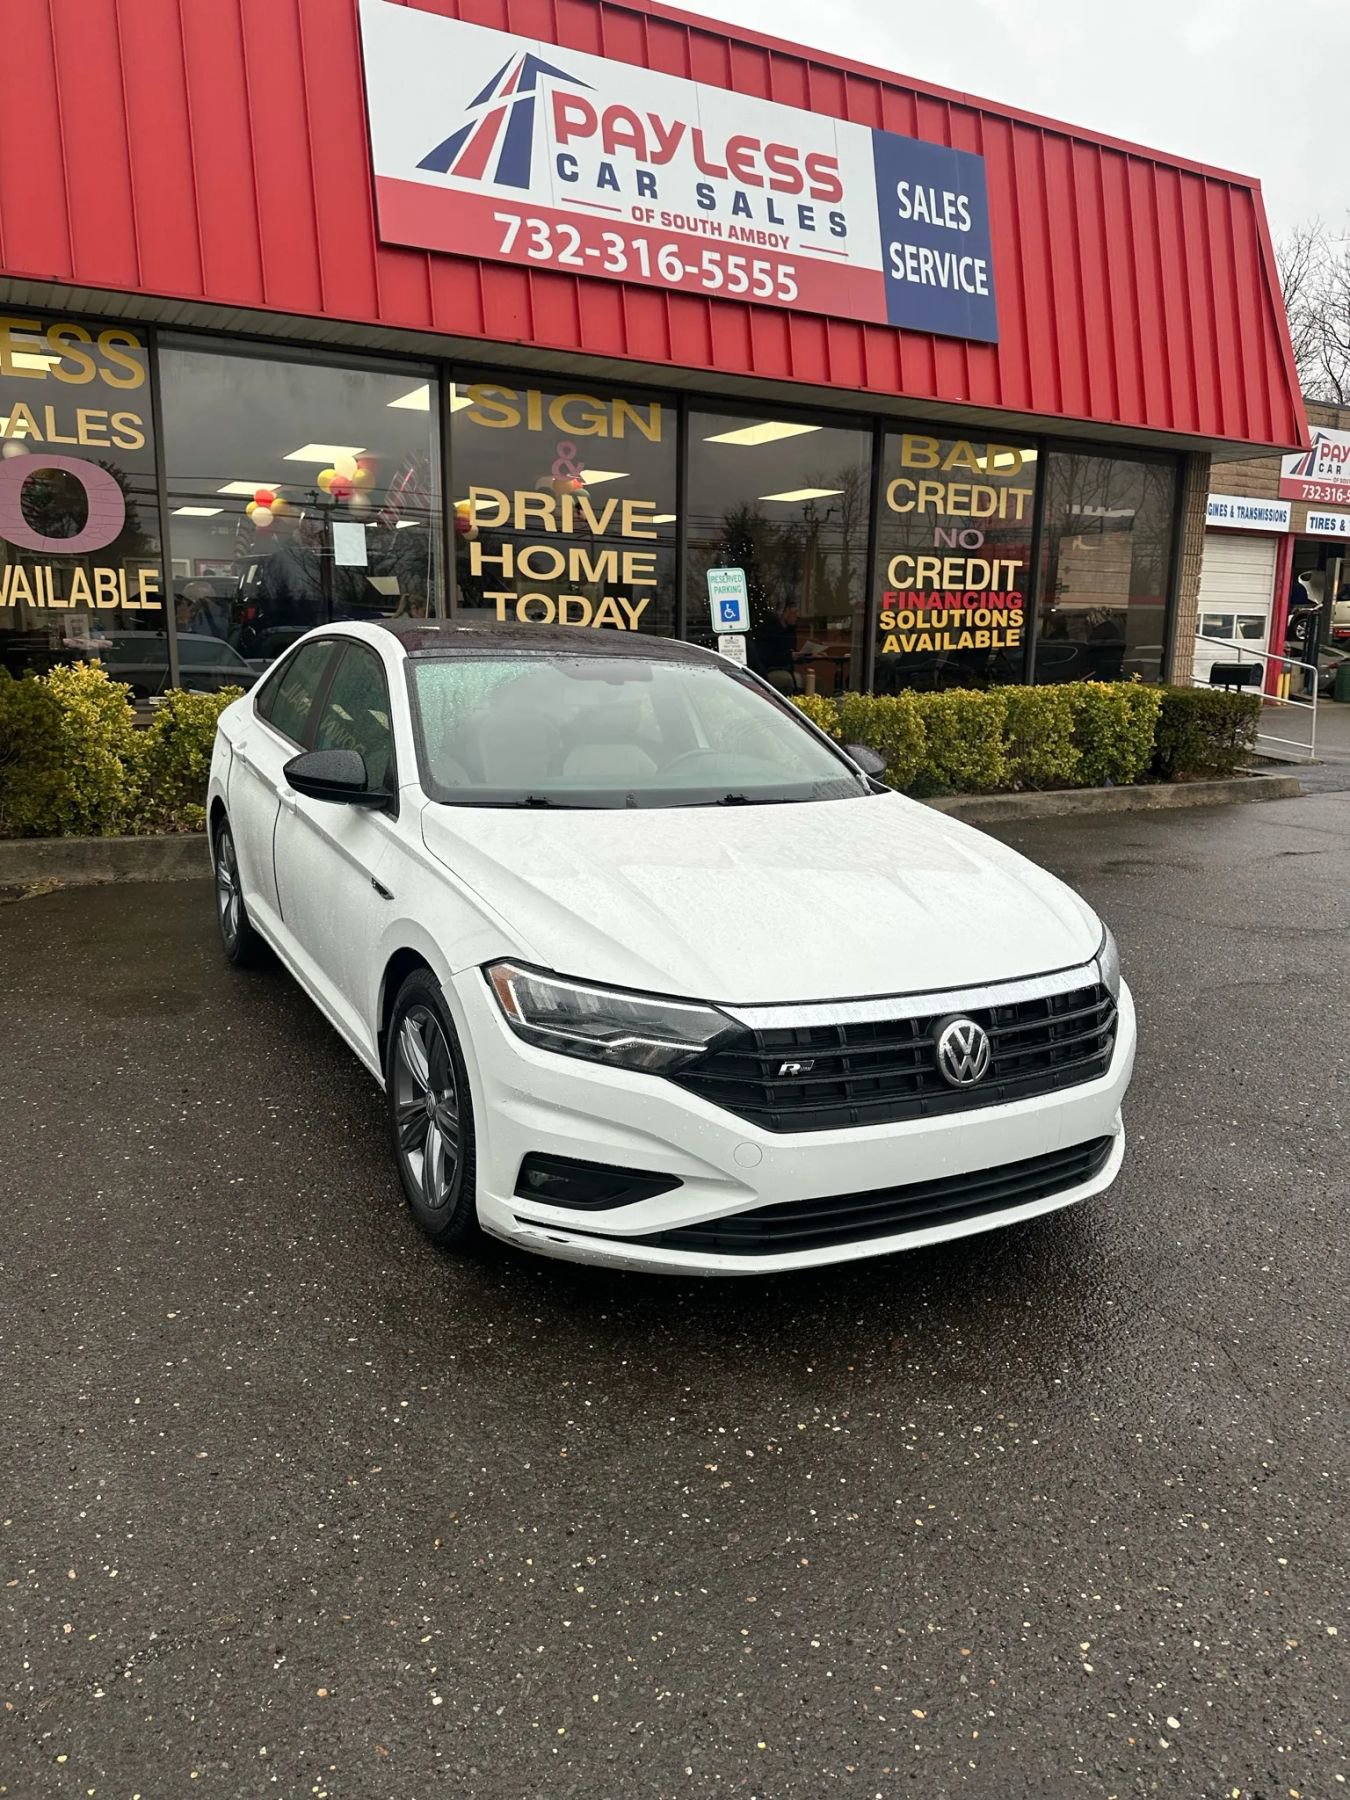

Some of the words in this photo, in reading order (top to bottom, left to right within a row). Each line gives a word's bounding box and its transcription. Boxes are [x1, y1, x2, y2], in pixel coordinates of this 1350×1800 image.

[551, 89, 845, 205] PAYLESS
[555, 152, 658, 200] CAR
[696, 182, 848, 238] SALES
[896, 180, 972, 233] SALES
[631, 205, 656, 224] OF
[660, 209, 721, 238] SOUTH
[728, 220, 791, 250] AMBOY
[494, 212, 798, 302] 732-316-5555
[889, 242, 990, 298] SERVICE
[467, 384, 662, 442] SIGN
[901, 433, 1023, 477] BAD
[1318, 462, 1342, 475] CAR
[469, 486, 657, 539] DRIVE
[886, 478, 1033, 520] CREDIT
[1237, 506, 1287, 523] TRANSMISSIONS
[933, 527, 985, 550] NO
[1310, 516, 1337, 531] TIRES
[470, 542, 658, 586] HOME
[887, 555, 1023, 592] CREDIT
[713, 585, 742, 594] PARKING
[882, 591, 1023, 610] FINANCING
[483, 591, 651, 631] TODAY
[879, 608, 1024, 630] SOLUTIONS
[881, 629, 1021, 654] AVAILABLE
